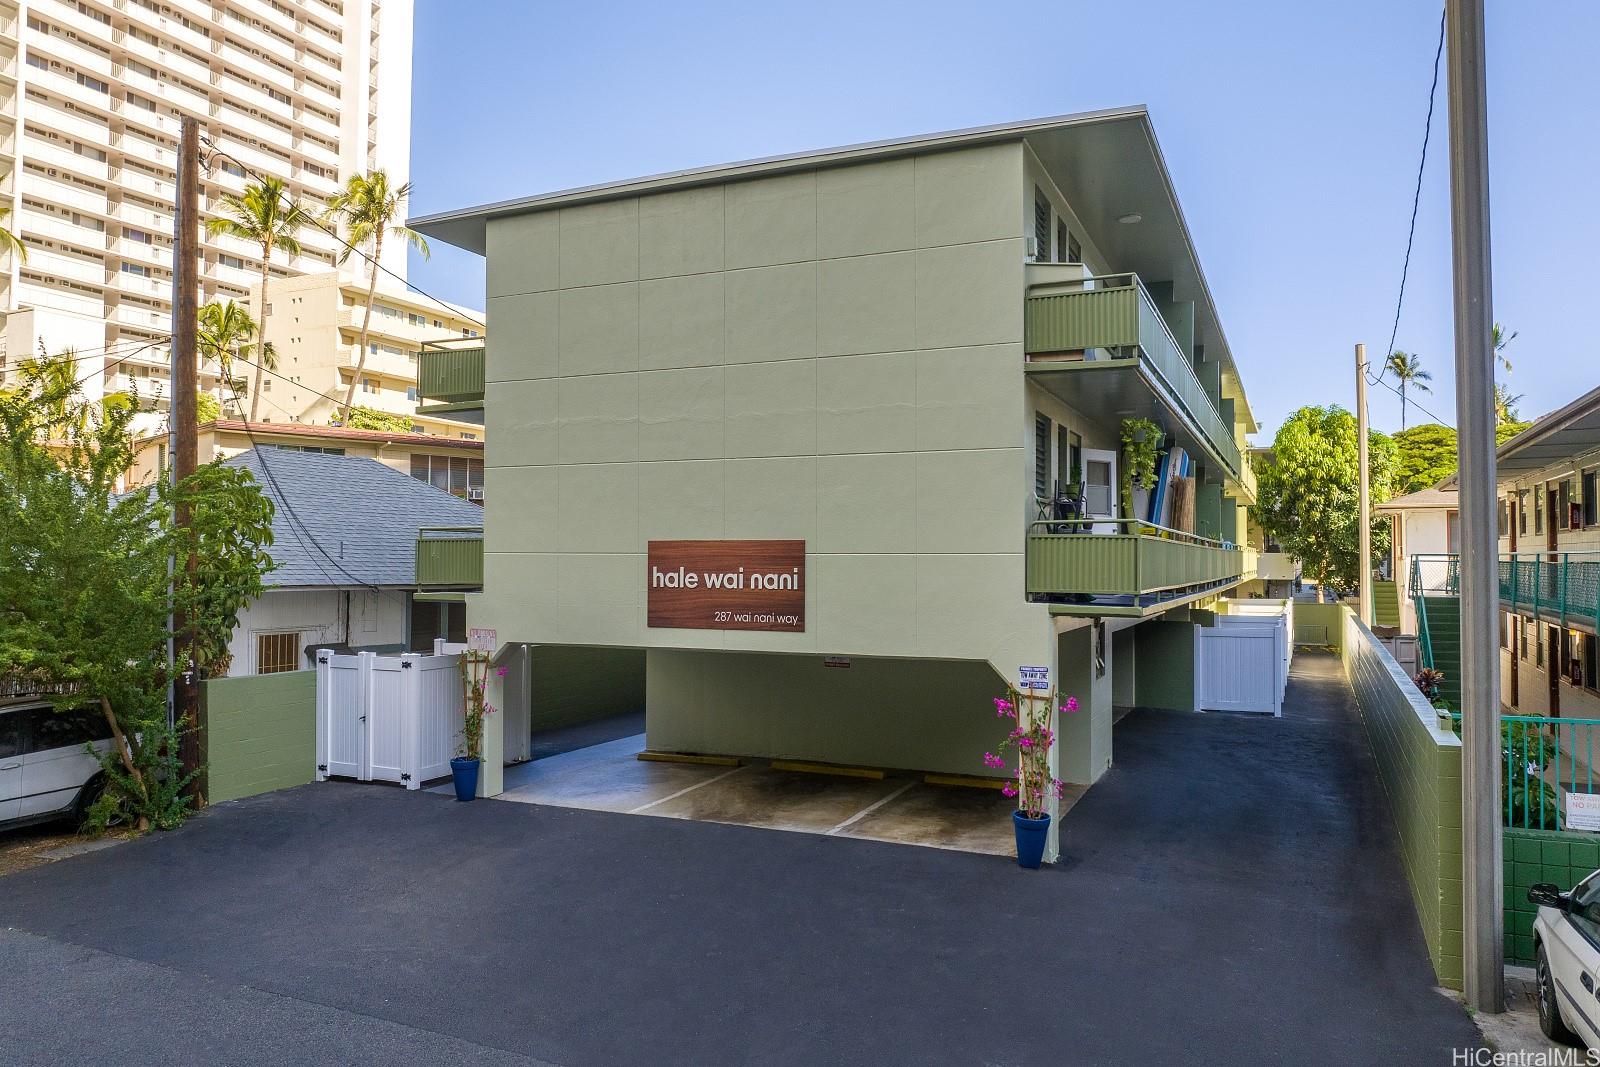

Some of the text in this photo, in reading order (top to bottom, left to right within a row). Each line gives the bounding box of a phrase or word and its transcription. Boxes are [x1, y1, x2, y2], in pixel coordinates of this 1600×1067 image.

[652, 566, 799, 590] hale wai nani
[714, 611, 799, 626] 287 wai nani way
